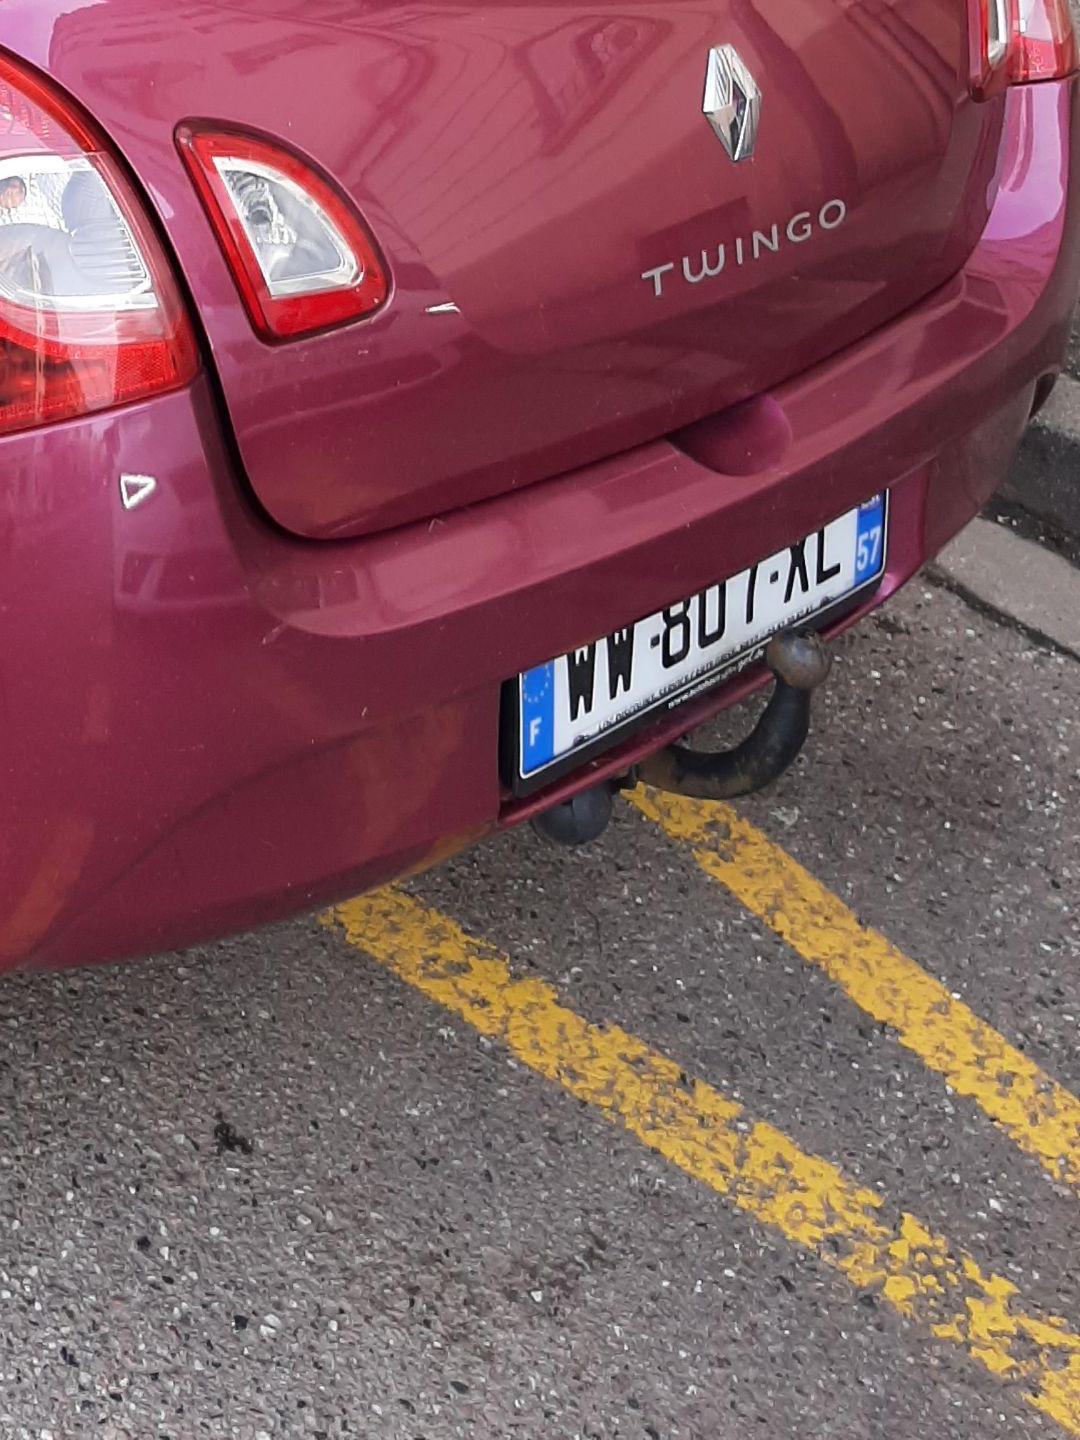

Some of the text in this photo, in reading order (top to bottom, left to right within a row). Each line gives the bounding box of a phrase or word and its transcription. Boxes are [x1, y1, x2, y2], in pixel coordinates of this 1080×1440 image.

[640, 199, 847, 297] TWINGO
[855, 525, 883, 572] 57
[528, 716, 543, 748] F
